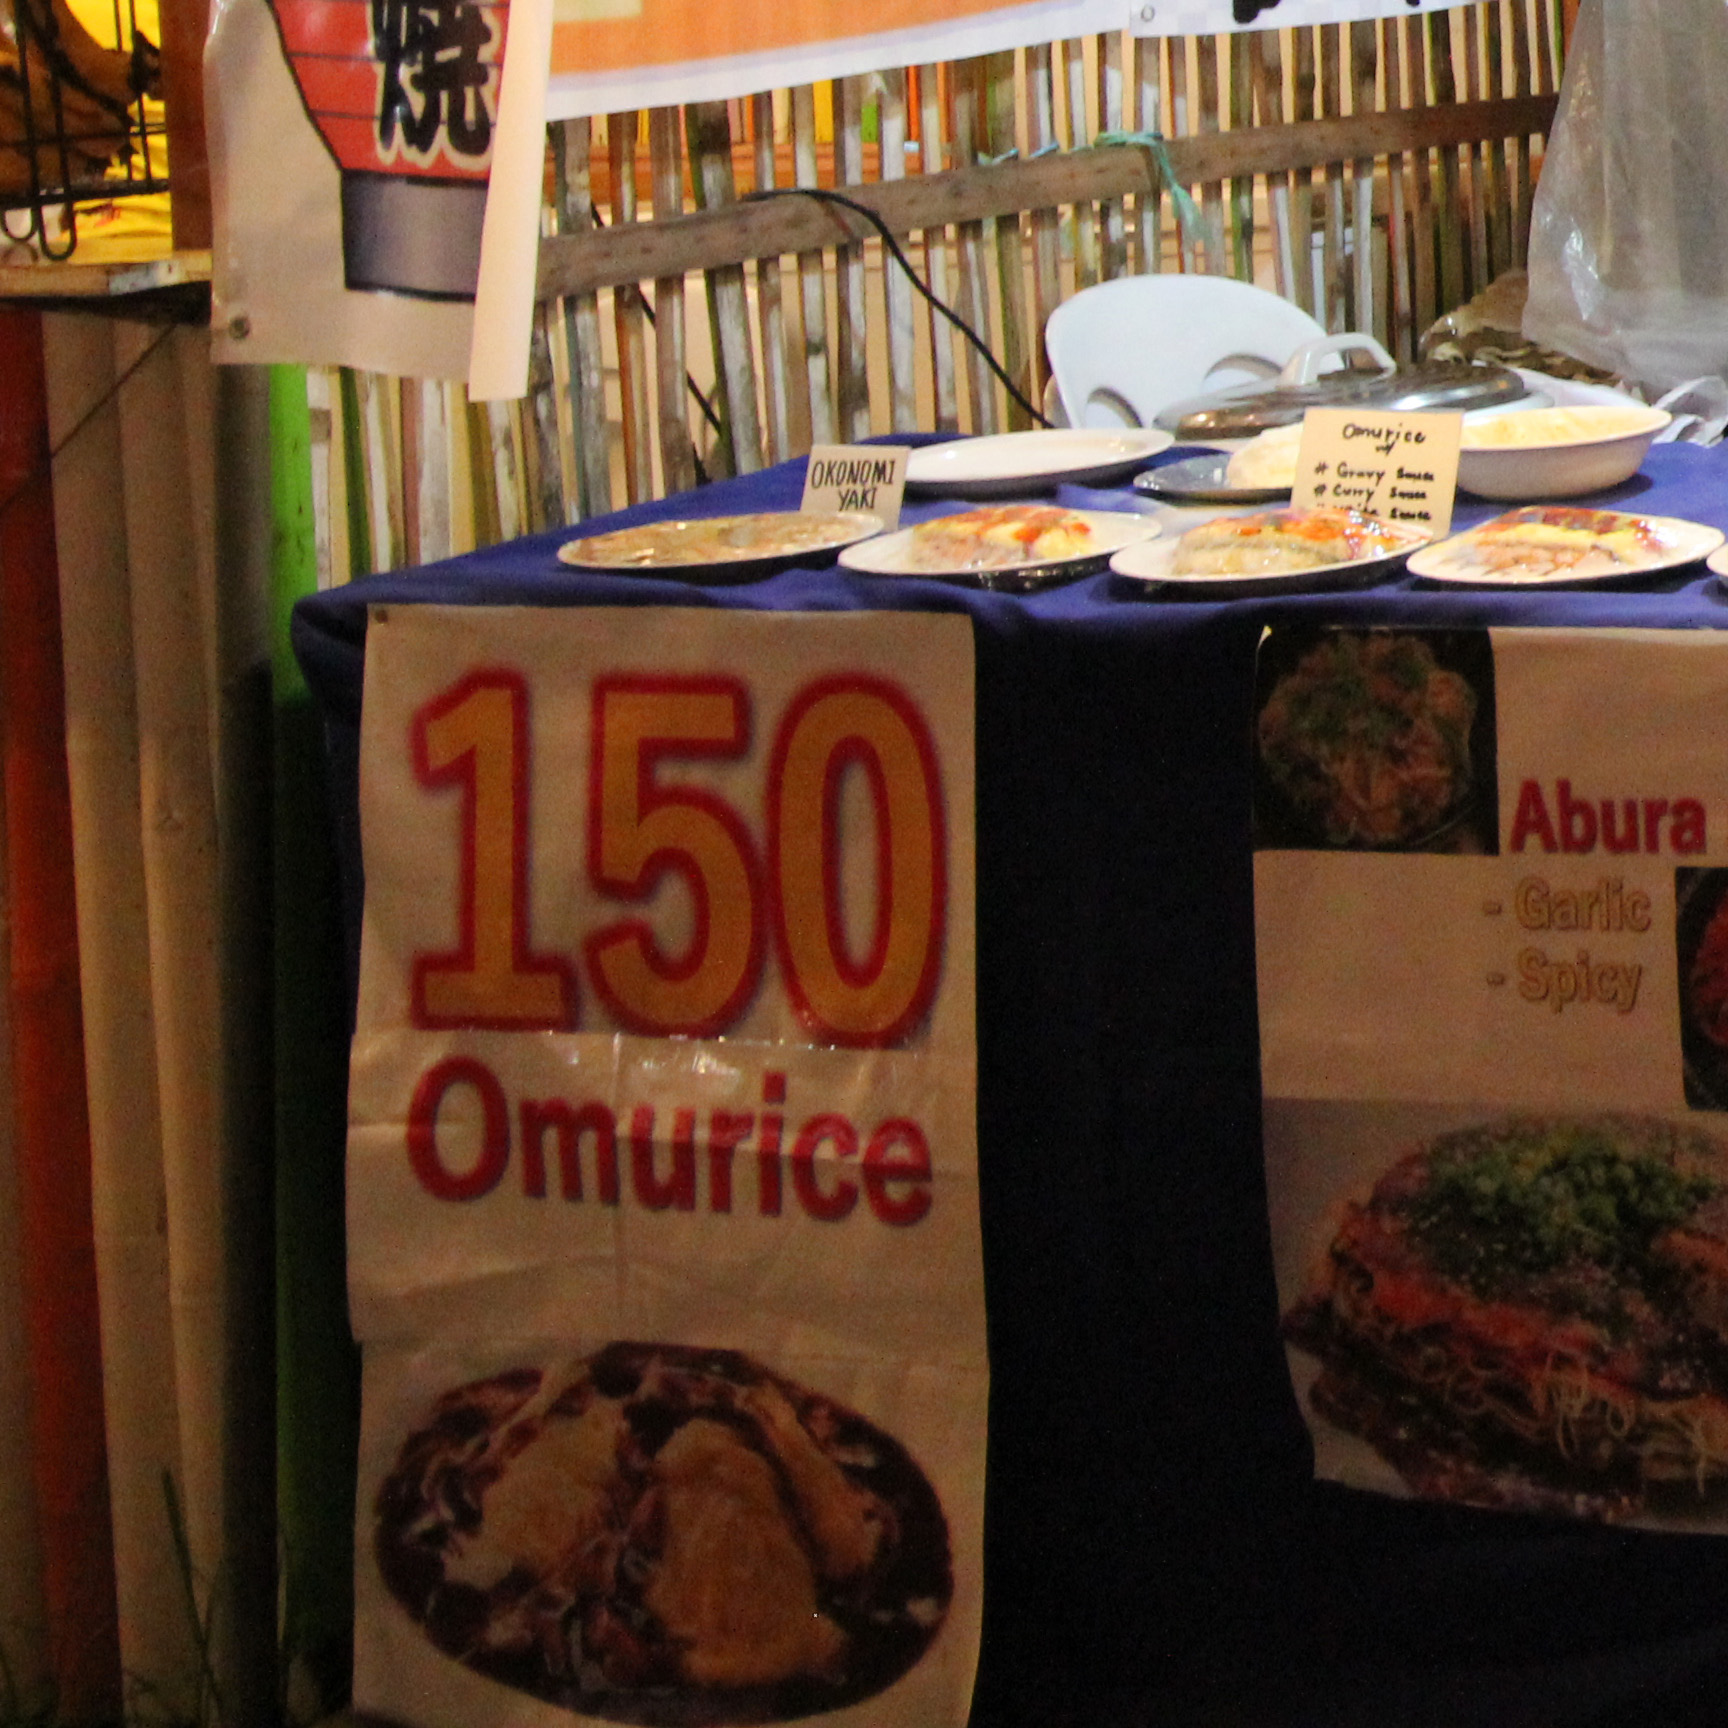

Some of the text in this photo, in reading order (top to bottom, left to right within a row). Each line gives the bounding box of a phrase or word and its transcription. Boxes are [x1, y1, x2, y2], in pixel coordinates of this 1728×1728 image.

[811, 459, 895, 489] OKONOMI
[838, 487, 877, 512] YAKI
[1333, 483, 1375, 505] Curry
[1337, 461, 1385, 487] Gravy
[1509, 778, 1707, 857] Abura
[405, 664, 946, 1049] 150
[1513, 876, 1652, 932] Garlic
[1516, 948, 1642, 1013] Spicy
[404, 1056, 934, 1226] Omurice
